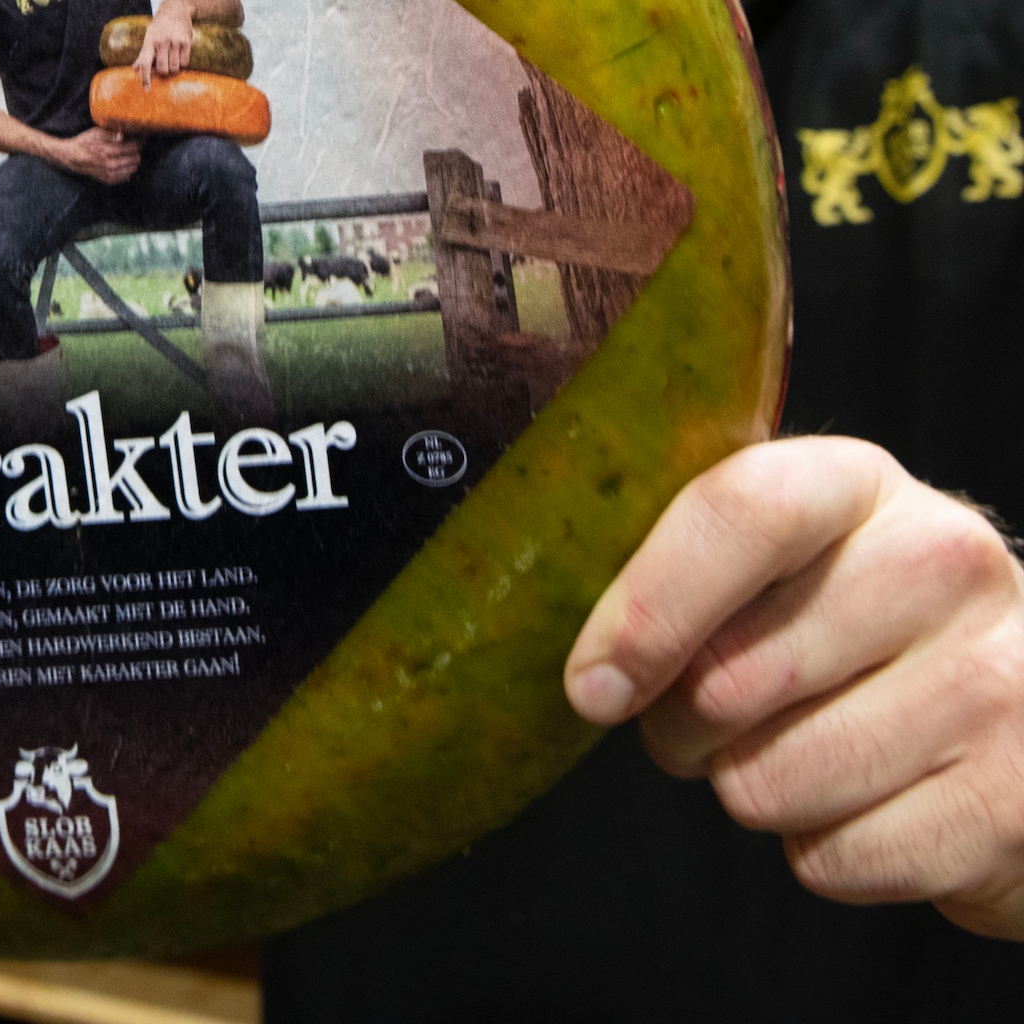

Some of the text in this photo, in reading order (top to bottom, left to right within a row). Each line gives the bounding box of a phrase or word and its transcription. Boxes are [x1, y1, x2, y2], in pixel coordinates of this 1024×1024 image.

[16, 579, 42, 599] DE
[45, 575, 96, 597] ZORG
[101, 572, 153, 593] VOOR
[158, 569, 195, 590] HET
[23, 604, 110, 626] GEMAAKT
[116, 601, 154, 623] MET
[159, 600, 186, 619] DE
[28, 630, 173, 657] HARDWERKEND
[37, 665, 76, 685] MET
[80, 659, 179, 683] KARAKTER
[184, 651, 240, 677] GAAN!
